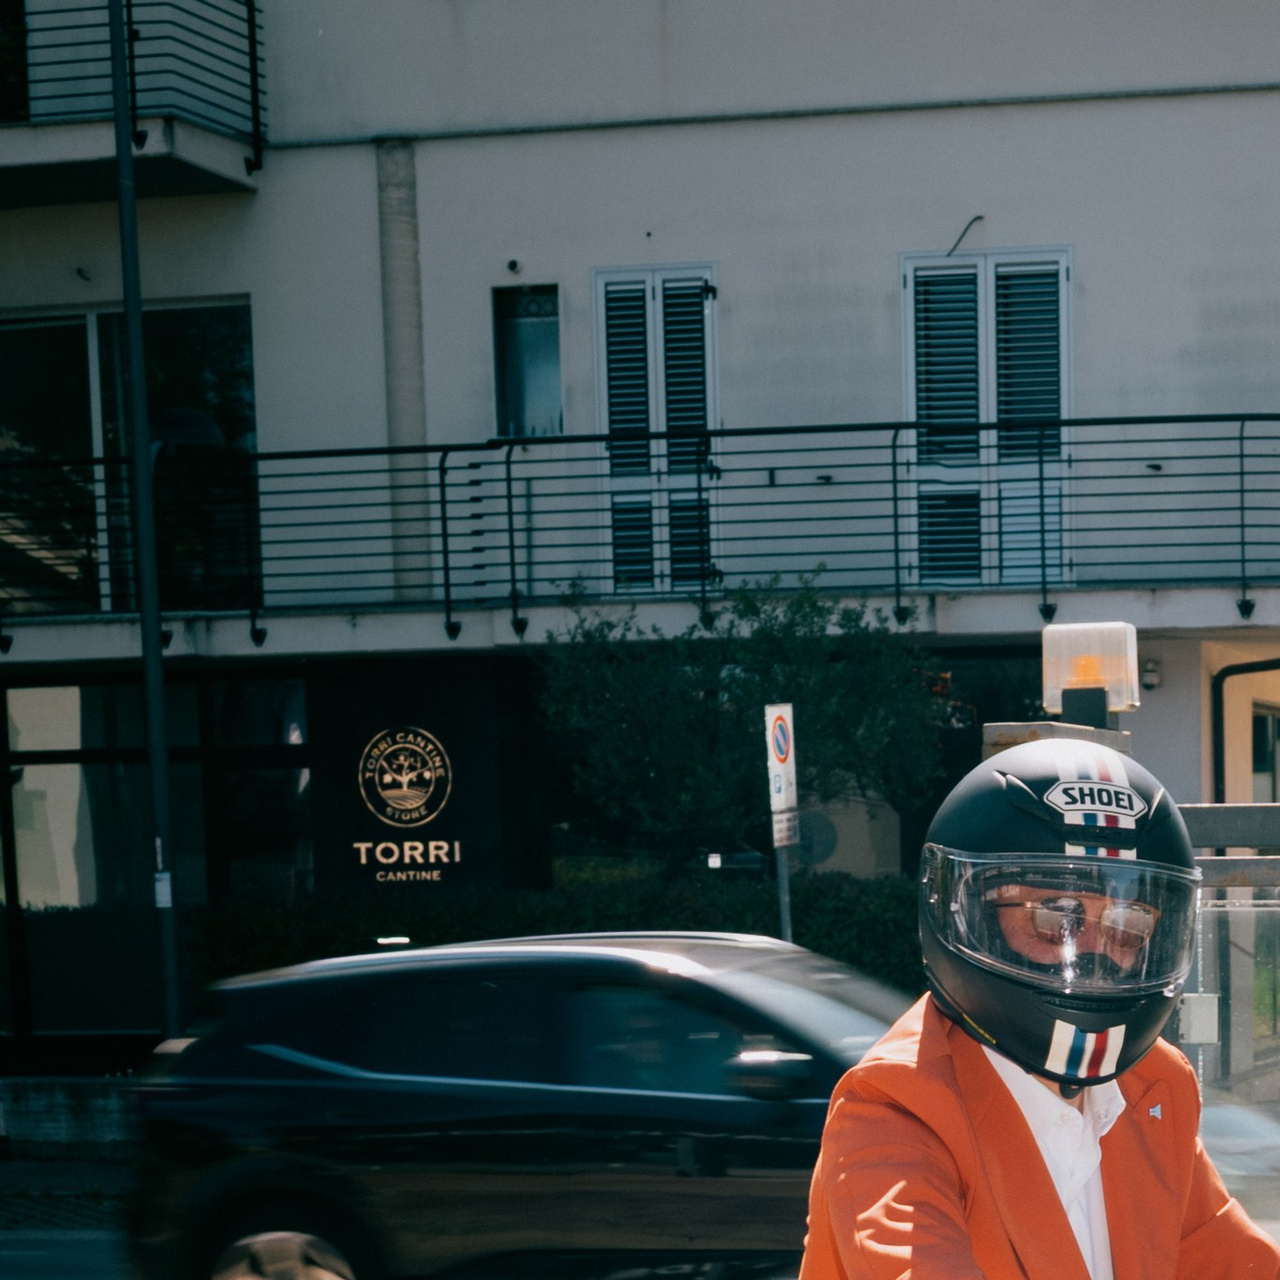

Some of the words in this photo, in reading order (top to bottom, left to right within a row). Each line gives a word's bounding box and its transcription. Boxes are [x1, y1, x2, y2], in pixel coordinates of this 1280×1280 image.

[365, 736, 393, 779] TORRI
[396, 732, 446, 778] CANTINE
[1062, 786, 1135, 811] SHOEI
[385, 804, 429, 820] STORE
[352, 840, 461, 865] TORRI
[376, 870, 442, 882] CANTINE
